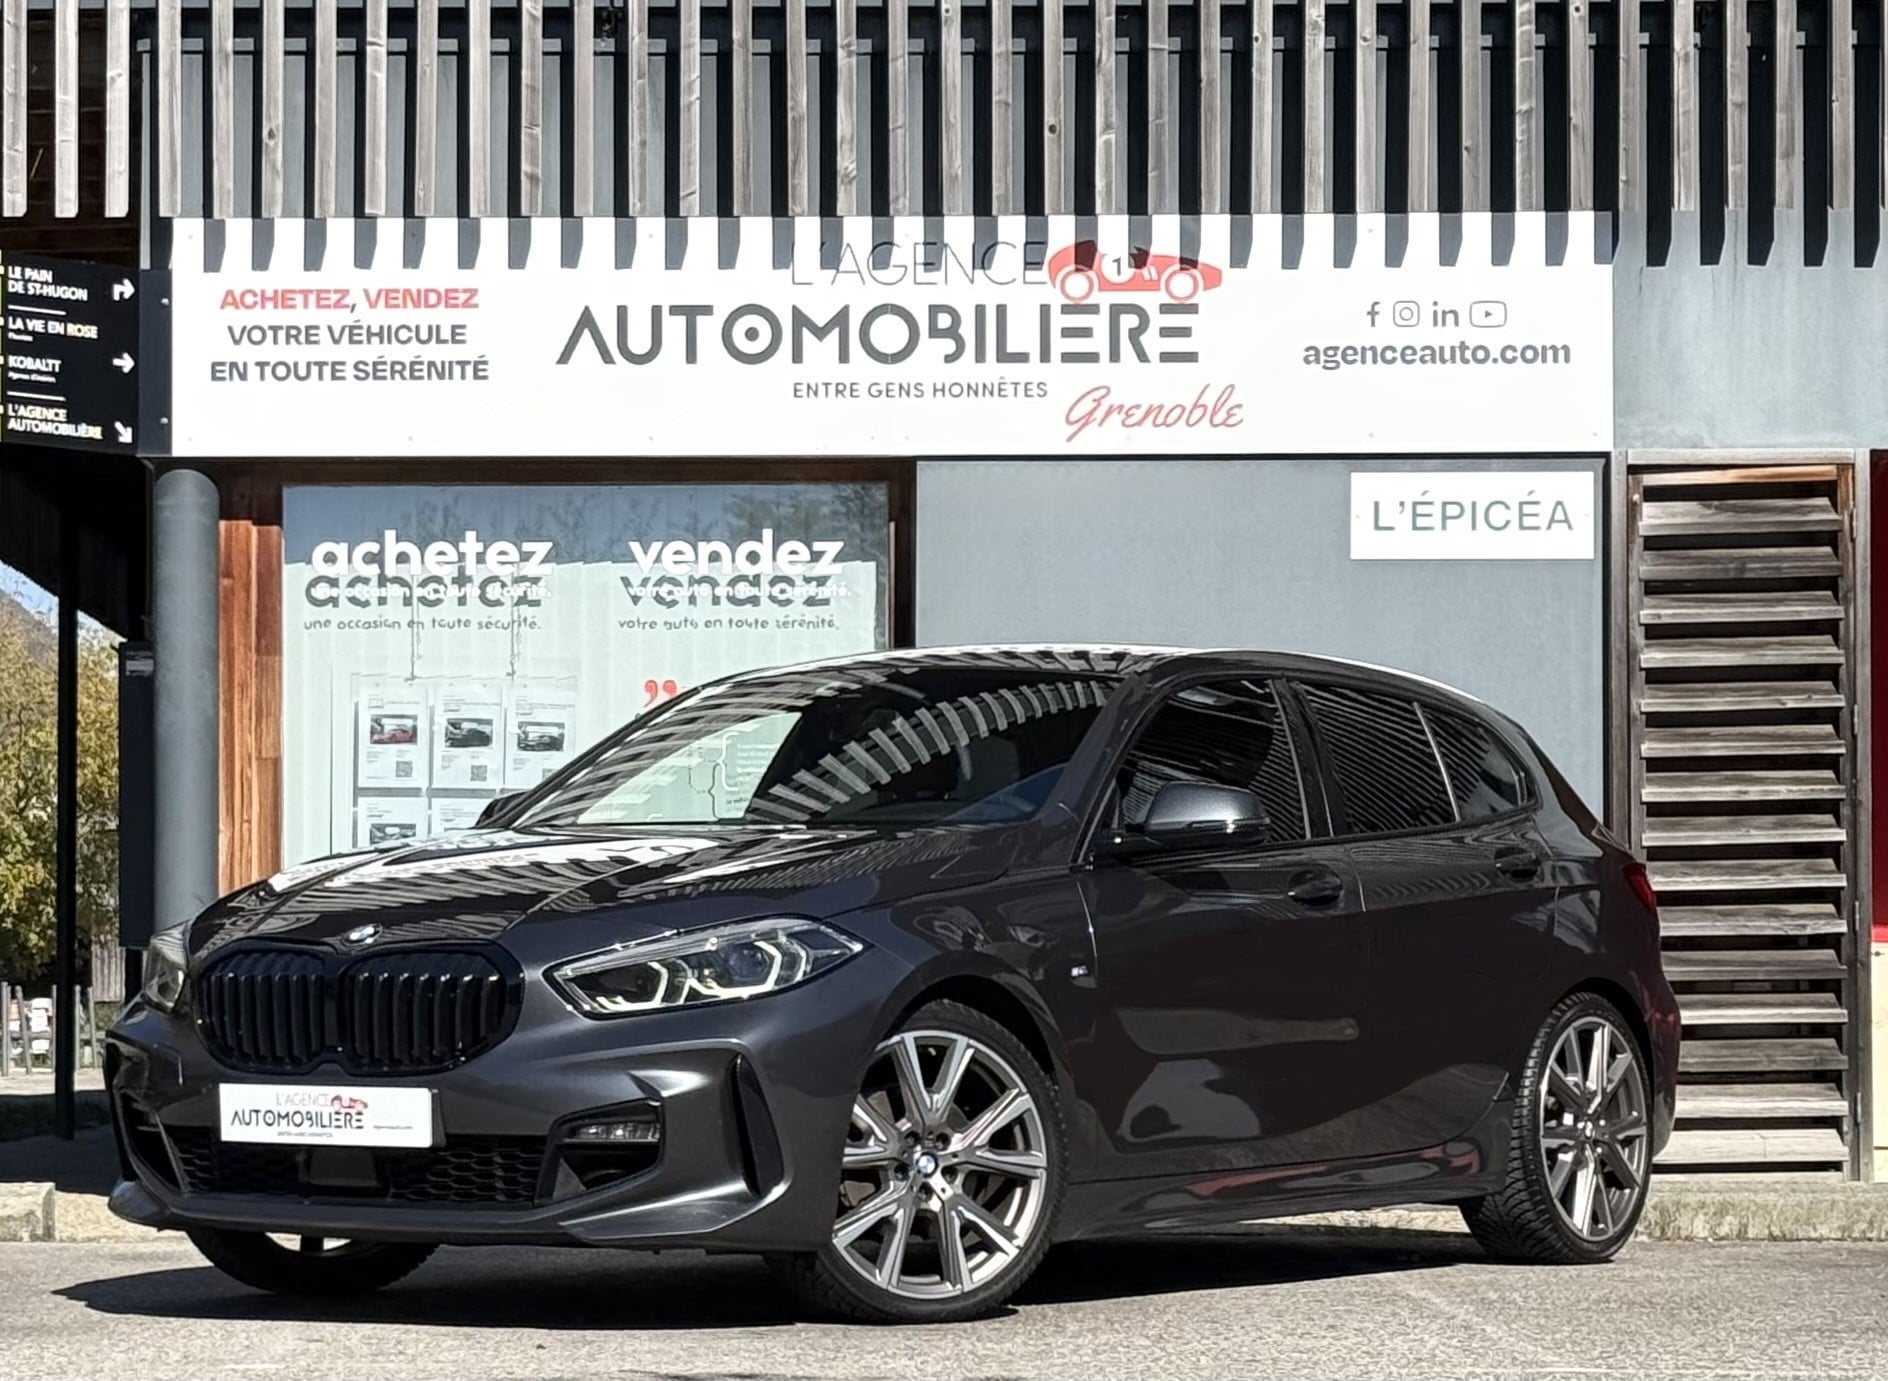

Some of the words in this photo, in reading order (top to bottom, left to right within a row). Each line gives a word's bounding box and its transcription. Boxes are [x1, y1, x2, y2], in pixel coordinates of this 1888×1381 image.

[8, 265, 22, 279] LE
[24, 267, 53, 283] PAIN
[791, 240, 1048, 286] L'AGENCE
[8, 280, 25, 294] DE
[27, 282, 88, 301] ST-HUGON
[219, 288, 356, 313] ACHETEZ,
[363, 288, 479, 310] VENDEZ
[8, 316, 24, 330] LA
[26, 318, 45, 332] VIE
[47, 320, 65, 335] EN
[66, 322, 98, 339] ROSE
[227, 324, 321, 346] VOTRE
[327, 319, 467, 345] VÉHICULE
[210, 361, 247, 382] EN
[254, 360, 347, 382] TOUTE
[353, 354, 489, 381] SÉRÉNITÉ
[1302, 340, 1571, 370] agenceauto.com
[793, 382, 860, 398] ENTRE
[868, 382, 925, 398] GENS
[933, 376, 1048, 398] HONNÊTES
[8, 403, 67, 422] L'AGENCE
[1065, 383, 1245, 442] Grenoble
[1373, 489, 1574, 532] L'ÉPICÉA
[311, 529, 553, 576] achetez
[628, 528, 844, 576] vendez
